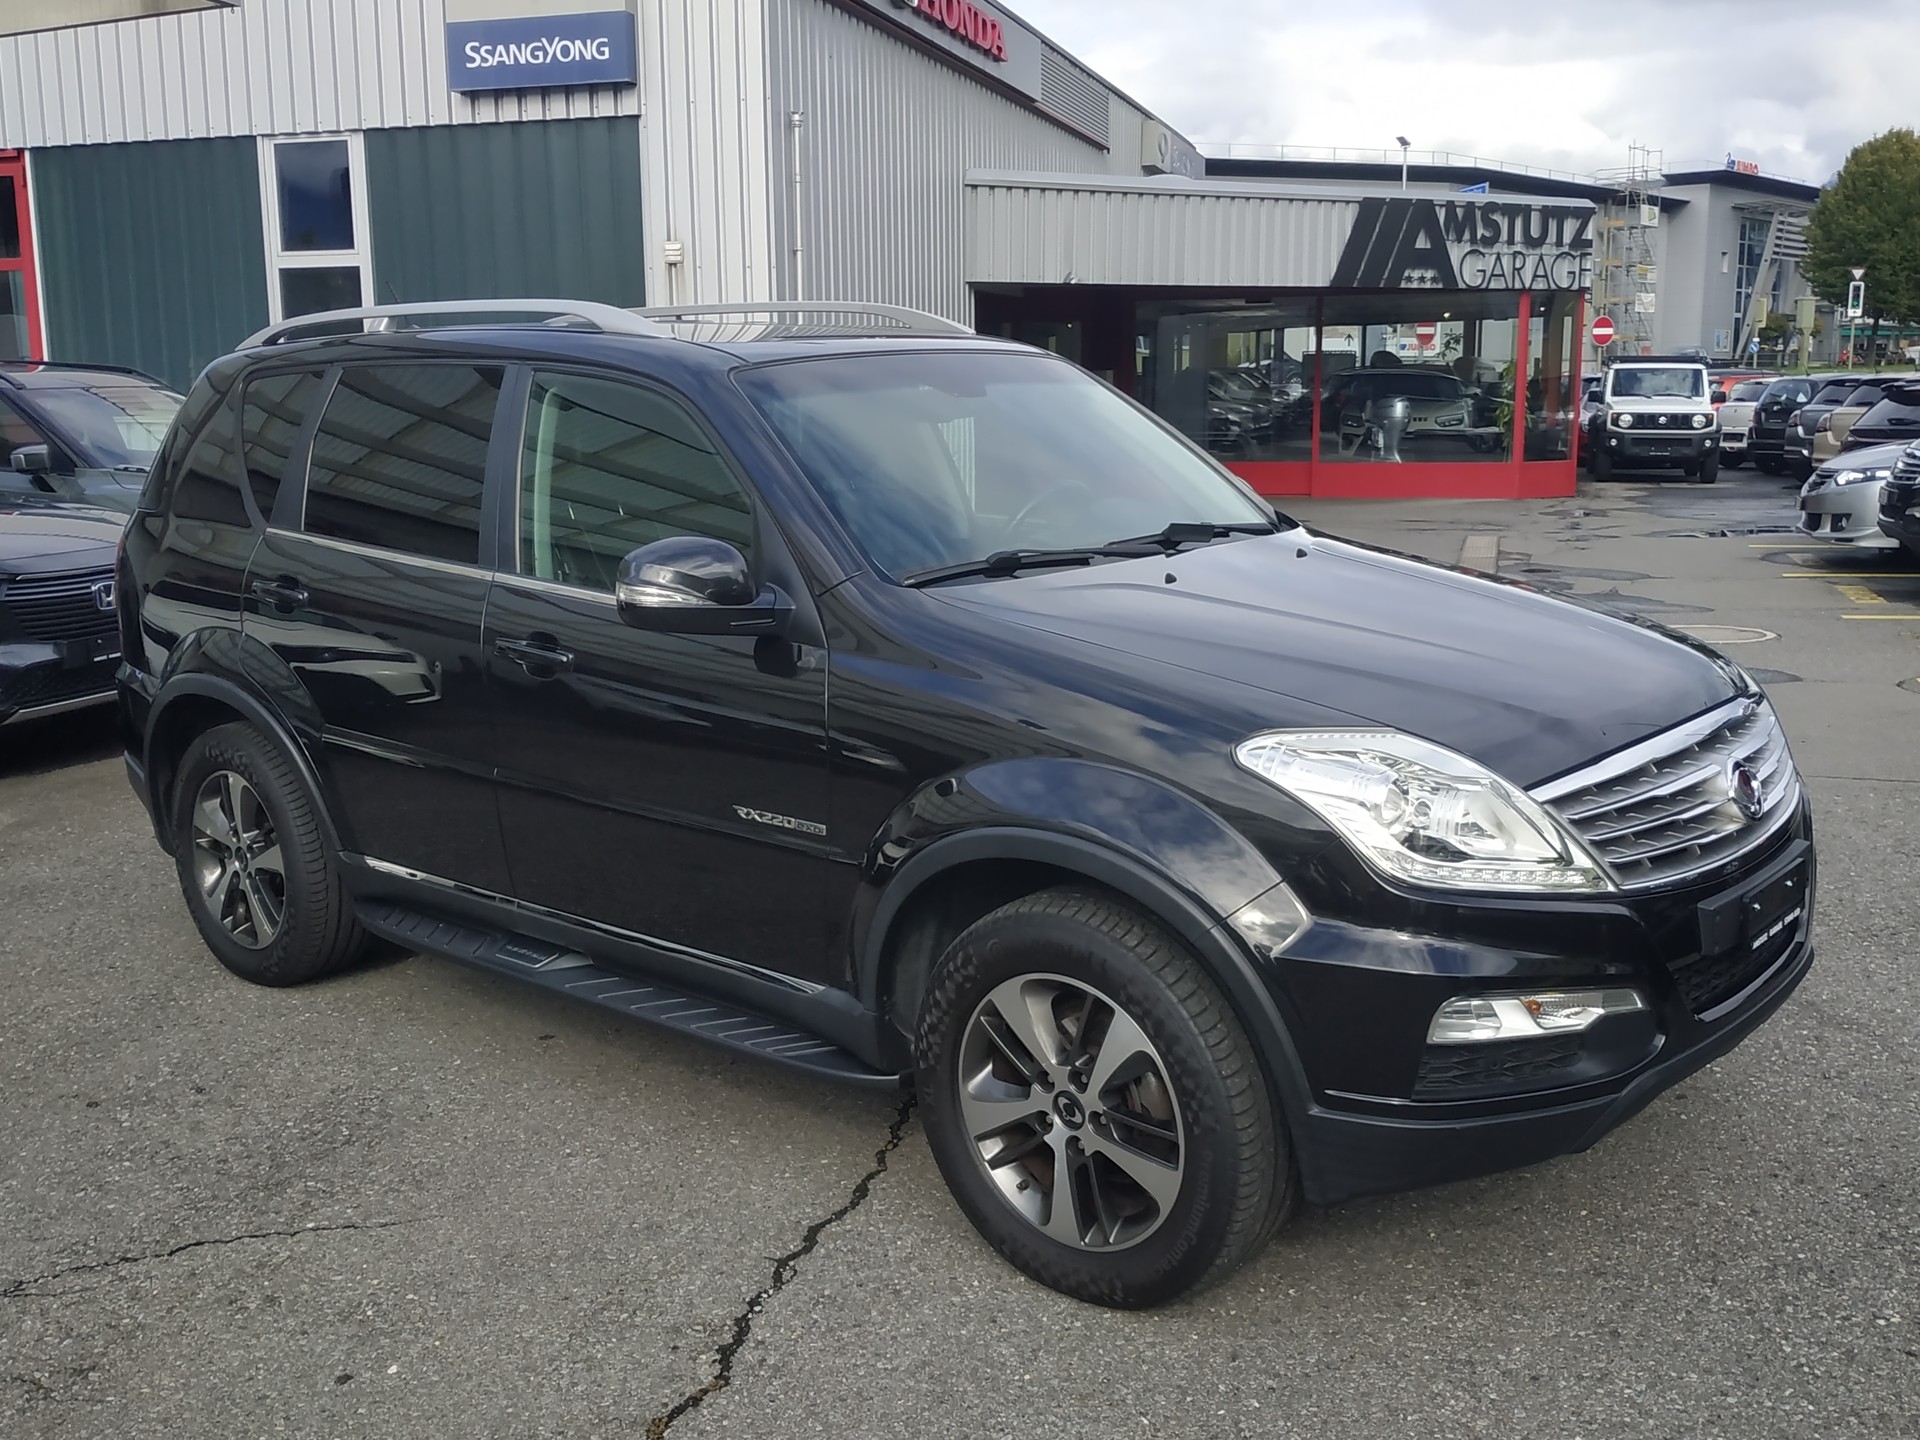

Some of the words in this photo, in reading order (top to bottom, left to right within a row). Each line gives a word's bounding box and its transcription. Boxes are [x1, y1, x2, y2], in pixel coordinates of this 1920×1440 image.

[464, 36, 610, 69] SSANGYONG
[1380, 197, 1597, 288] AMSTUTZ
[1459, 248, 1593, 290] GARAGE
